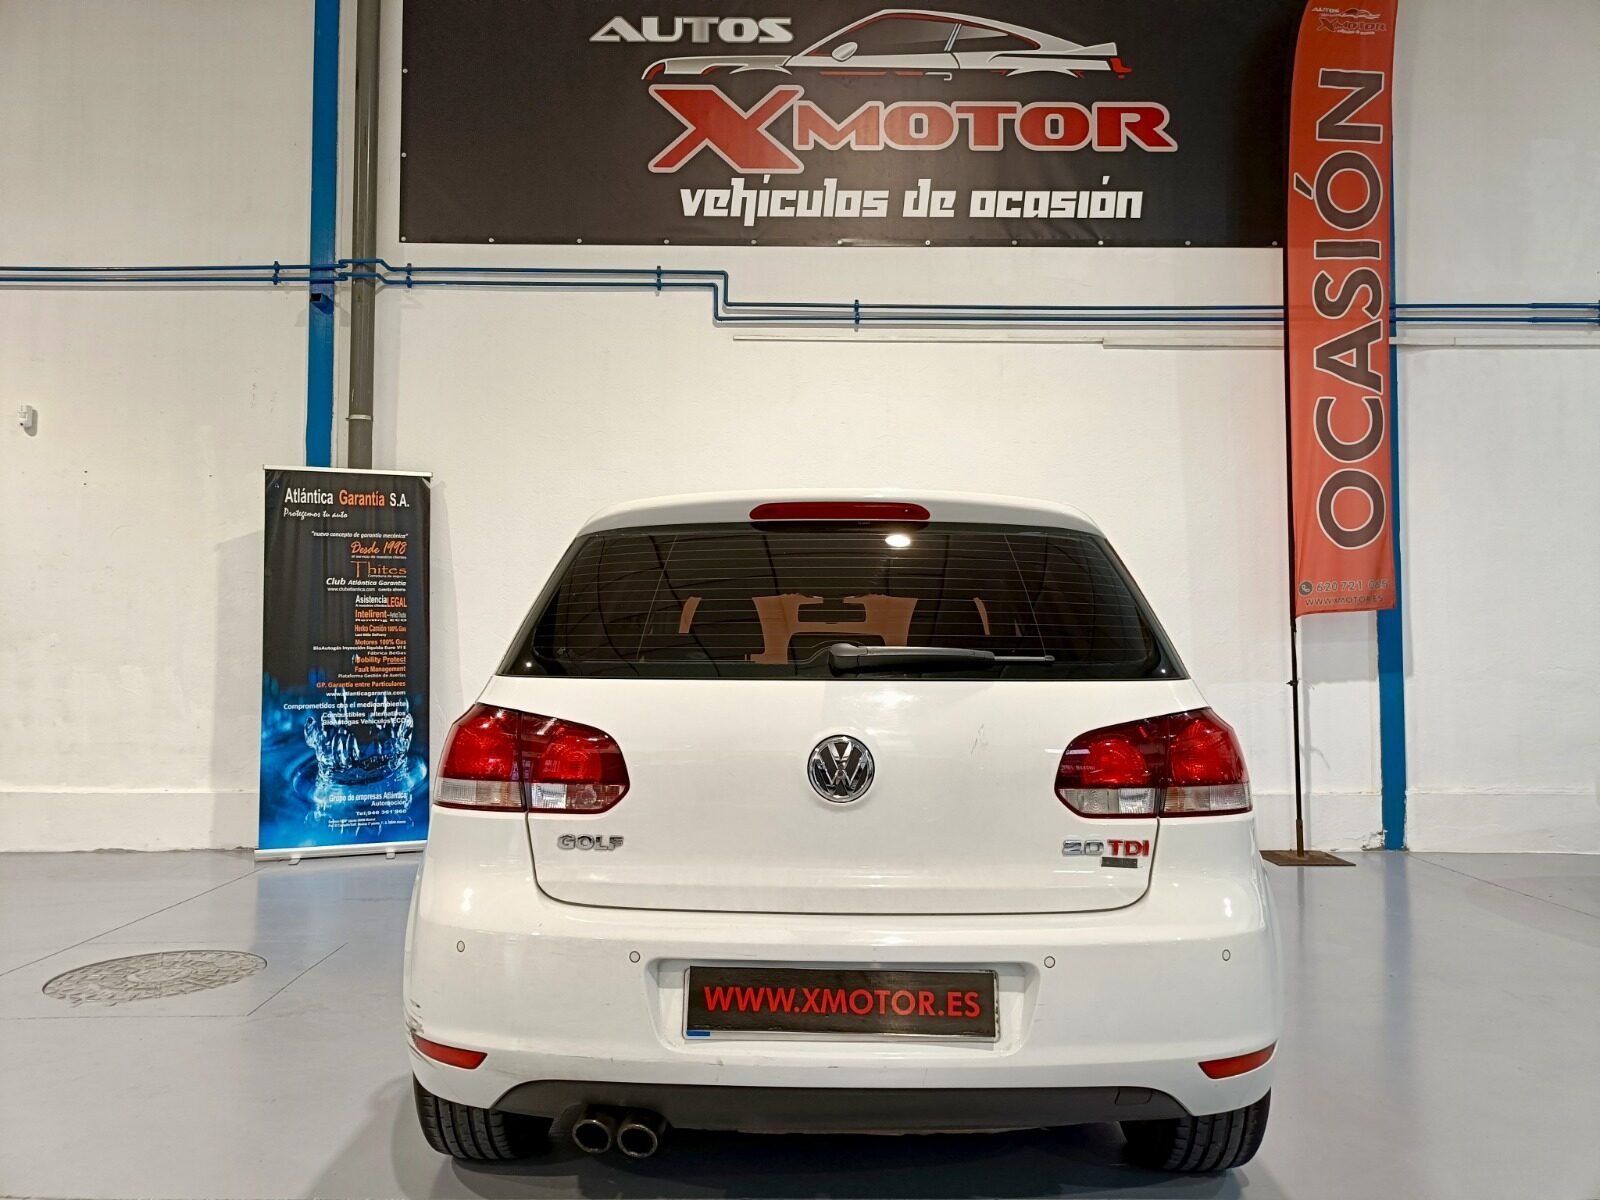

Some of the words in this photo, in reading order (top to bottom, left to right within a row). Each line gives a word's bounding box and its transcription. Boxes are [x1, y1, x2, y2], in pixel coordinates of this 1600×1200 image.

[589, 15, 795, 44] AUTOS
[1316, 17, 1386, 32] XMOTOR
[648, 84, 1178, 173] XMOTOR
[679, 174, 890, 226] vehículos
[902, 179, 957, 217] de
[969, 175, 1144, 218] ocasión
[1294, 68, 1386, 550] OCASIÓN
[284, 487, 334, 505] Atlántica
[389, 493, 410, 507] S.A.
[283, 507, 321, 520] Protegemos
[331, 511, 348, 519] auto
[350, 541, 380, 554] Desde
[383, 540, 408, 555] 1998
[326, 577, 346, 585] Club
[557, 834, 624, 851] GOLF
[1106, 838, 1150, 857] TDI
[703, 985, 981, 1017] WWW.XMOTOR.ES
